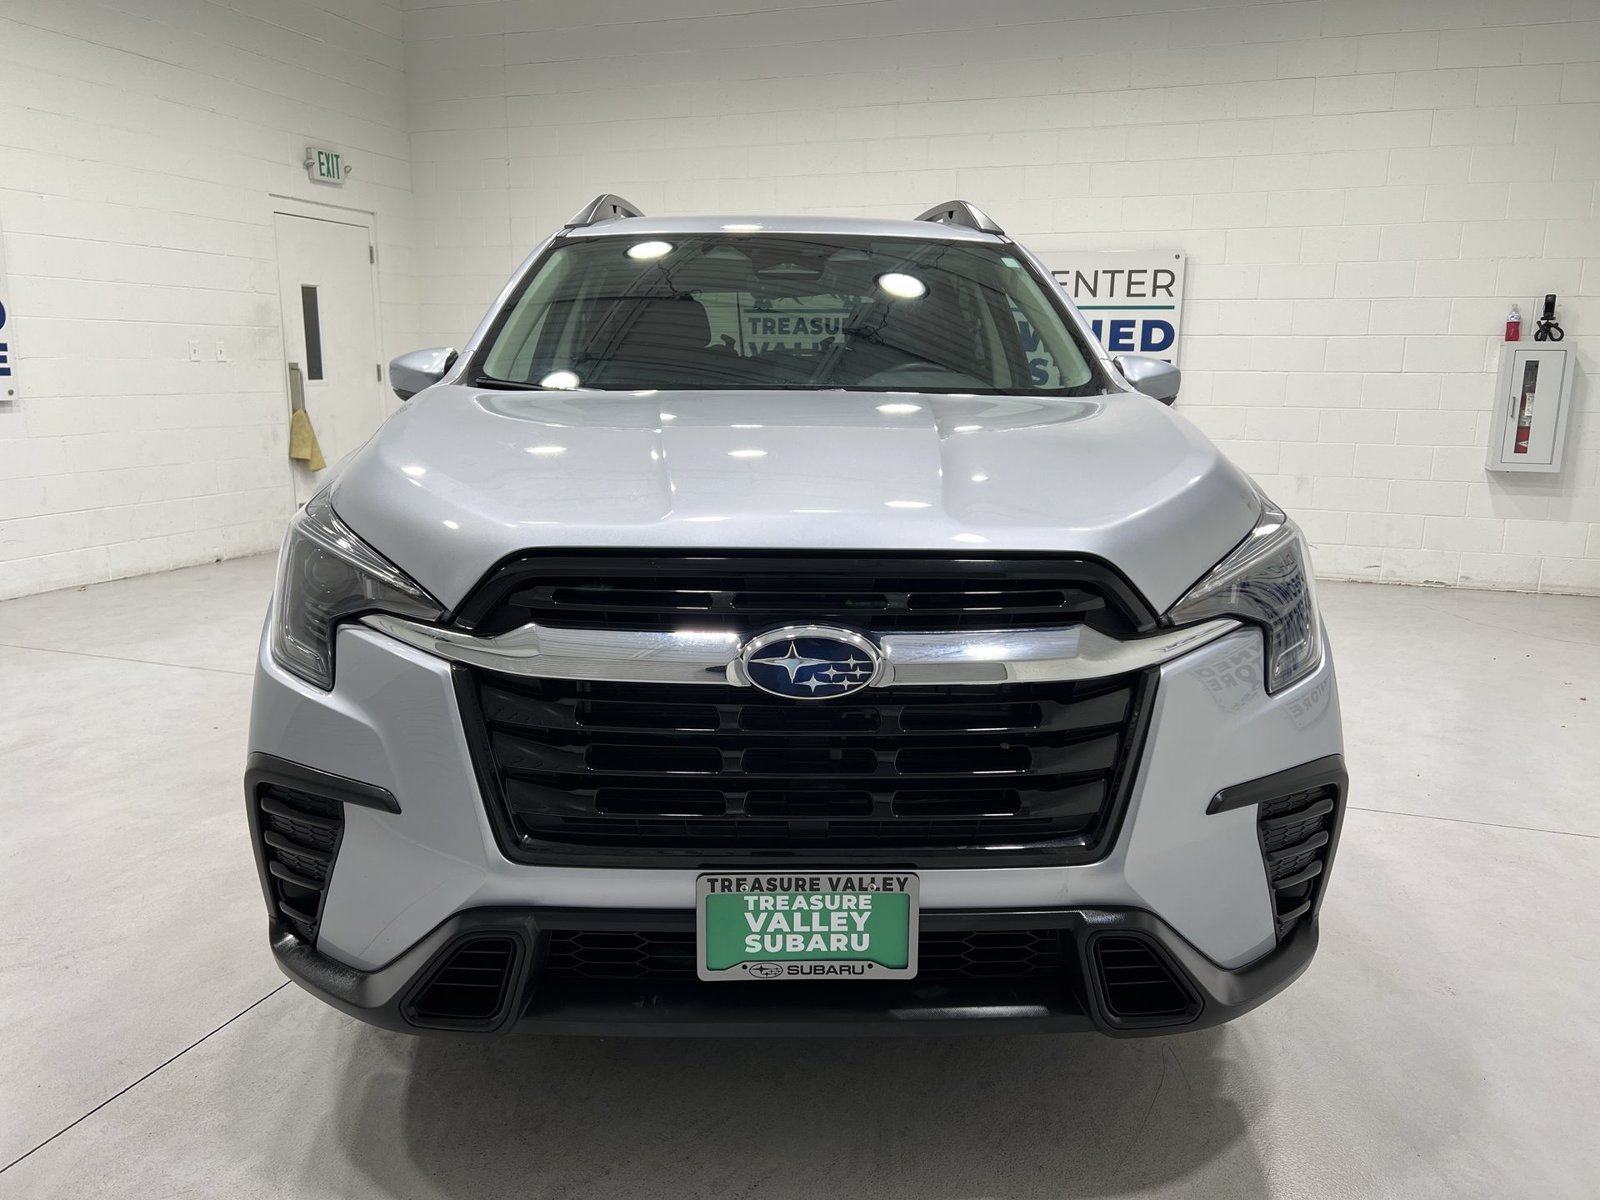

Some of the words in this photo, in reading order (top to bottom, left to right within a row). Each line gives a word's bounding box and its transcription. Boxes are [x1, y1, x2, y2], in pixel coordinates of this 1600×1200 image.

[317, 150, 340, 180] EXIT
[1051, 269, 1176, 298] ENTER
[748, 317, 850, 335] TREASU
[706, 877, 821, 893] TREASURE
[827, 877, 909, 892] VALLEY
[743, 895, 873, 910] TREASURE
[744, 912, 872, 932] VALLEY
[744, 933, 870, 953] SUBARU
[786, 964, 865, 976] SUBARU
